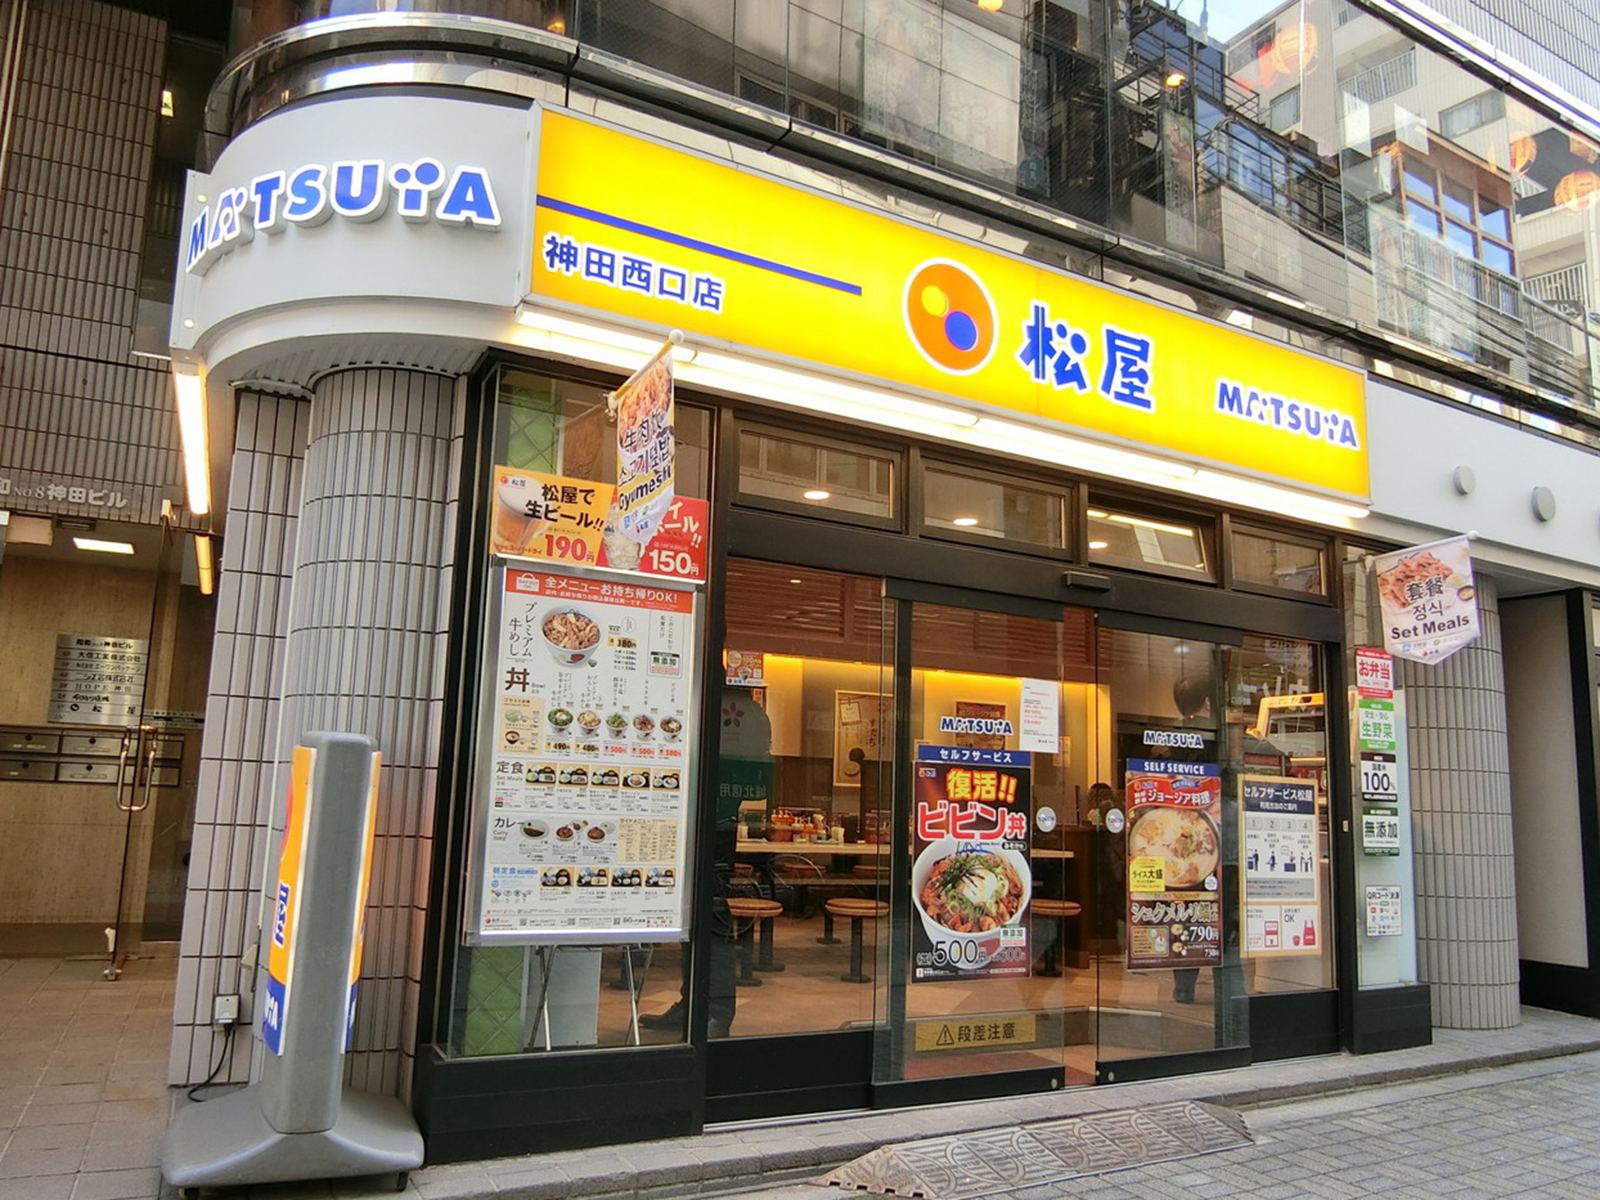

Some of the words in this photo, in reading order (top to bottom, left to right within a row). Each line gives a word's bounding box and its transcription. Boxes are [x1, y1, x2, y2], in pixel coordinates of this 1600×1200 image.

[543, 232, 726, 313] 神田西口店
[1019, 302, 1156, 412] 松屋
[1216, 379, 1358, 449] MATSUYA
[47, 483, 128, 508] 神田ビル
[541, 483, 596, 506] 松屋で
[523, 499, 605, 532] 生ビール!!
[545, 533, 595, 563] 190円
[650, 551, 699, 576] 150円
[544, 577, 678, 603] 全メニューお持ち帰りOK!
[1405, 576, 1444, 601] 套餐
[1412, 600, 1444, 622] 정식
[507, 617, 523, 657] 牛めし
[522, 602, 538, 657] プレミアム
[1391, 625, 1419, 640] Set
[1422, 614, 1470, 635] Meals
[505, 667, 530, 693] 丼
[1358, 661, 1391, 681] お弁当
[1361, 720, 1393, 739] 生野菜
[496, 761, 524, 774] 定食
[939, 748, 1013, 763] セルフサービス
[1144, 761, 1165, 772] SELF
[1167, 763, 1204, 774] SERVICE
[946, 767, 1019, 803] 復活!!
[1147, 789, 1211, 806] ジョージア料理
[494, 817, 526, 828] カレー
[917, 800, 1027, 841] ビビン丼
[1364, 821, 1398, 839] 無添加
[1132, 869, 1164, 880] ライス大盛
[1284, 914, 1295, 922] OK
[957, 1021, 1016, 1042] 段差注意
